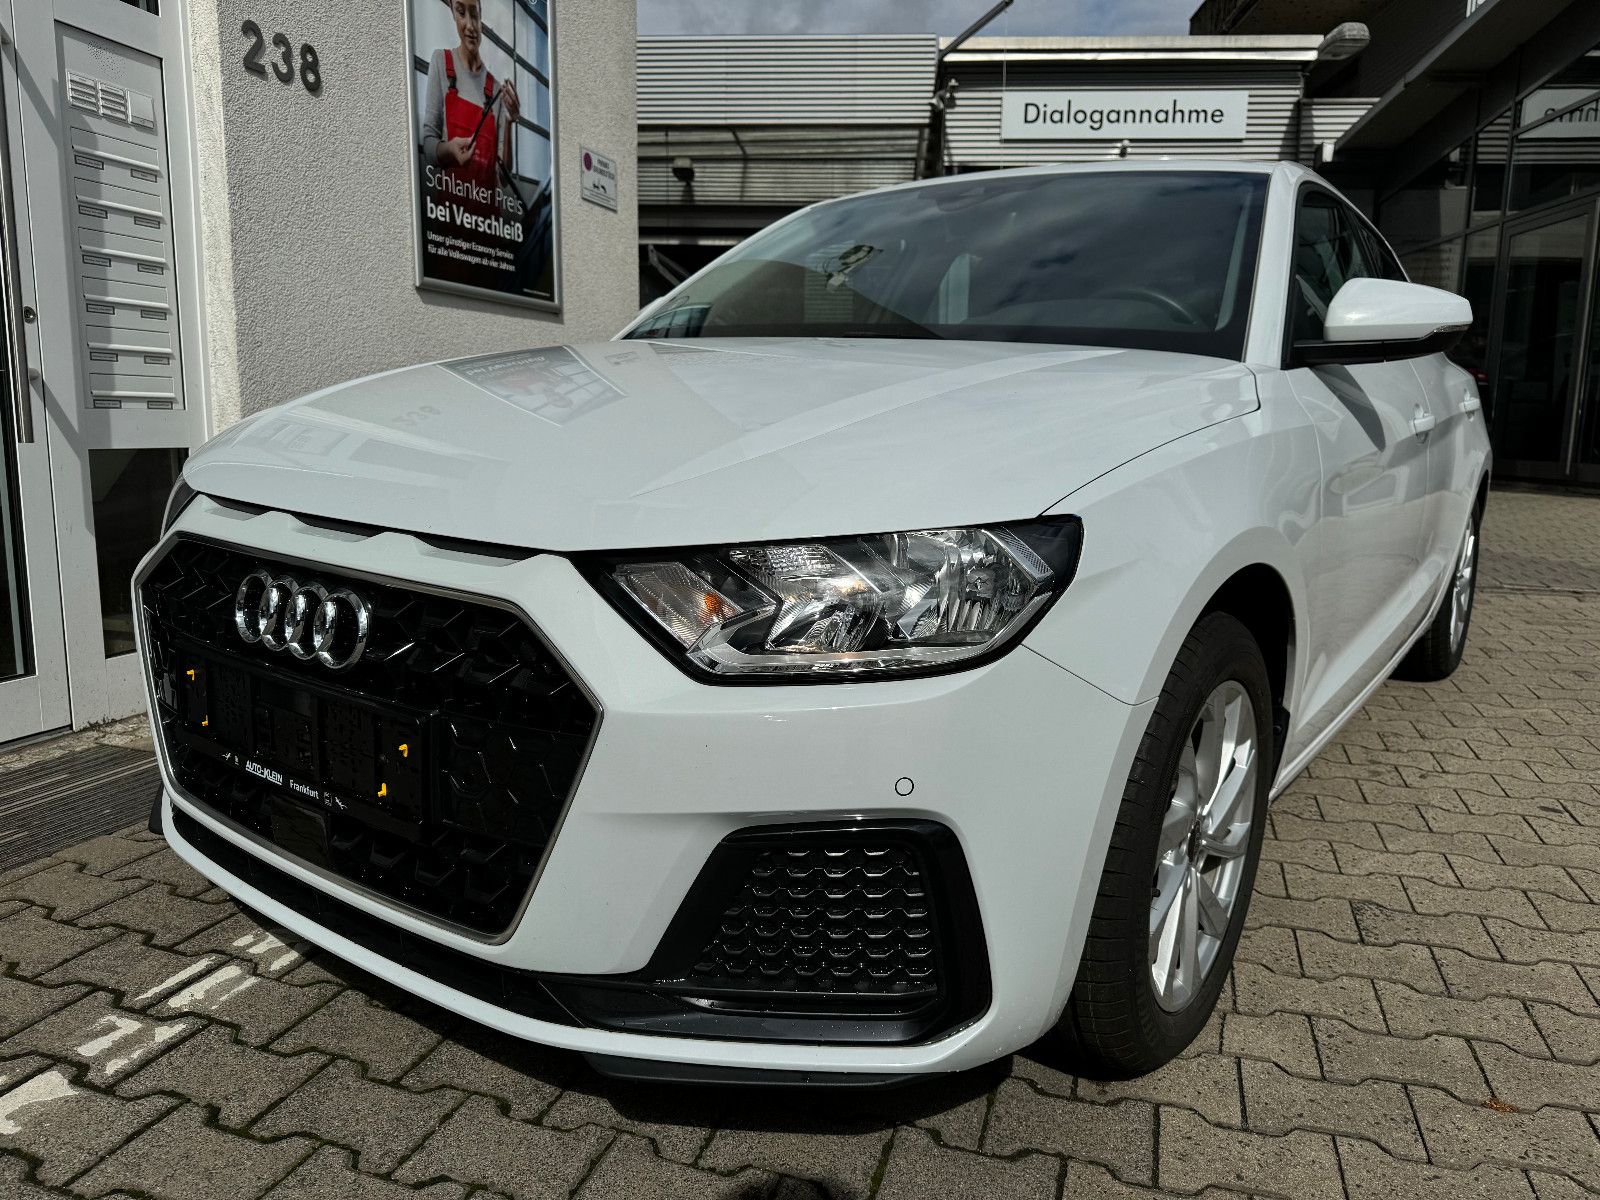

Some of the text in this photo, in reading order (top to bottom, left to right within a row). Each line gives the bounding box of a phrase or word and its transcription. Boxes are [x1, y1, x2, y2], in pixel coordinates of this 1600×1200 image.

[241, 19, 321, 92] 238
[1024, 99, 1224, 130] Dialogannahme
[425, 164, 524, 216] Schlanker Preis
[426, 195, 524, 242] bei Verschleiß
[427, 230, 445, 242] Unser
[445, 235, 472, 250] günstiger
[472, 241, 496, 257] Economy
[448, 248, 481, 264] Volkswagen
[245, 759, 283, 786] AUTO-KLEIN
[289, 779, 320, 800] Frankfurt
